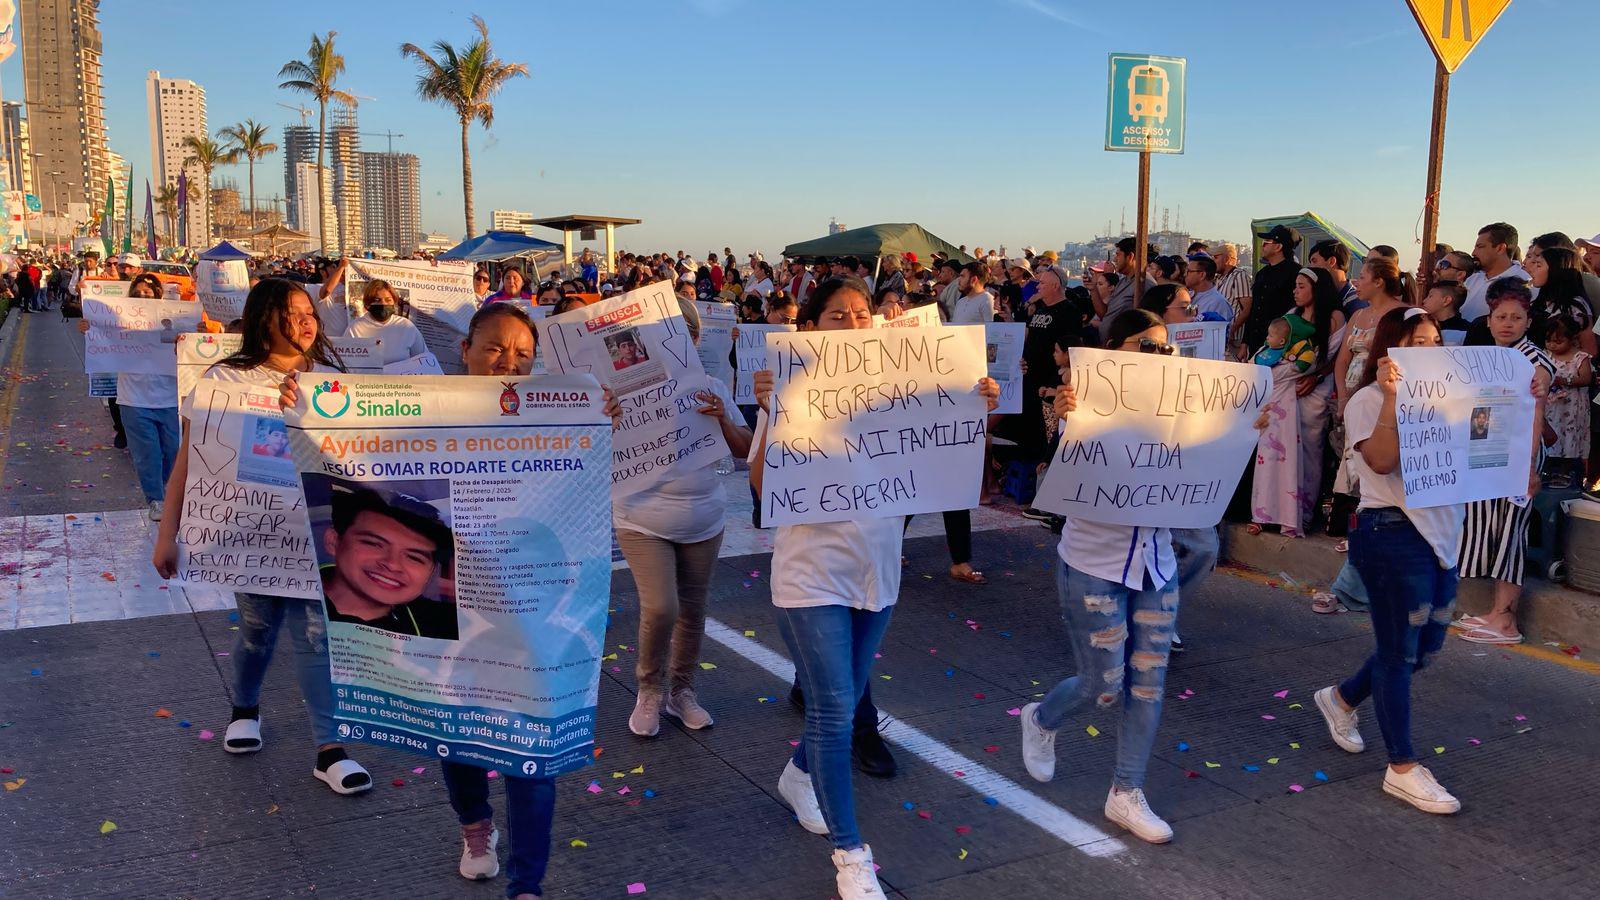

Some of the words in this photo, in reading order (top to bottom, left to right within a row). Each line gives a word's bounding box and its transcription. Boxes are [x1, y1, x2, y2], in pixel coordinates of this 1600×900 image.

[1122, 126, 1164, 136] ASCENSO
[1165, 128, 1172, 136] Y
[1123, 136, 1170, 147] DESCENSO
[403, 281, 436, 291] VERDUGO
[437, 285, 473, 295] CERVANTES
[416, 273, 459, 284] encontrar
[588, 318, 602, 329] SE
[603, 304, 639, 323] BUSCA
[776, 334, 956, 384] ¡AYUDENME
[526, 392, 590, 402] SINALOA
[773, 394, 788, 427] A
[807, 379, 923, 422] REGRESAR
[937, 383, 956, 407] A
[1156, 365, 1268, 418] LLEVARON
[356, 399, 422, 417] Sinaloa
[1399, 403, 1413, 425] SE
[1418, 404, 1435, 423] LO
[319, 434, 437, 459] Ayúdanos
[445, 437, 458, 452] a
[465, 433, 572, 452] encontrar
[578, 435, 591, 449] a
[632, 425, 691, 458] ERNESTO
[655, 433, 717, 467] CERVANTES
[765, 437, 829, 469] CASA
[844, 429, 898, 463] MI
[897, 418, 987, 455] FAMILIA
[1061, 439, 1108, 466] UNA
[1125, 442, 1182, 470] VIDA
[323, 460, 366, 477] JESÚS
[371, 462, 424, 477] OMAR
[430, 460, 507, 476] RODARTE
[511, 458, 584, 473] CARRERA
[1436, 449, 1453, 467] LO
[187, 477, 283, 511] AYUDAME
[770, 487, 809, 519] ME
[820, 470, 917, 513] ESPERA!
[177, 522, 278, 550] COMPARTE
[188, 551, 239, 567] KEVIN
[337, 688, 349, 698] Si
[353, 691, 386, 704] tienes
[389, 697, 452, 719] información
[458, 712, 509, 727] referente
[514, 720, 521, 729] a
[526, 721, 551, 733] esta
[338, 701, 368, 714] llama
[441, 722, 455, 734] Tu
[458, 725, 492, 738] ayuda
[495, 732, 508, 741] es
[510, 734, 536, 748] muy
[538, 727, 592, 749] importante.
[371, 731, 388, 741] 669
[389, 734, 405, 744] 327
[406, 738, 428, 750] 8424
